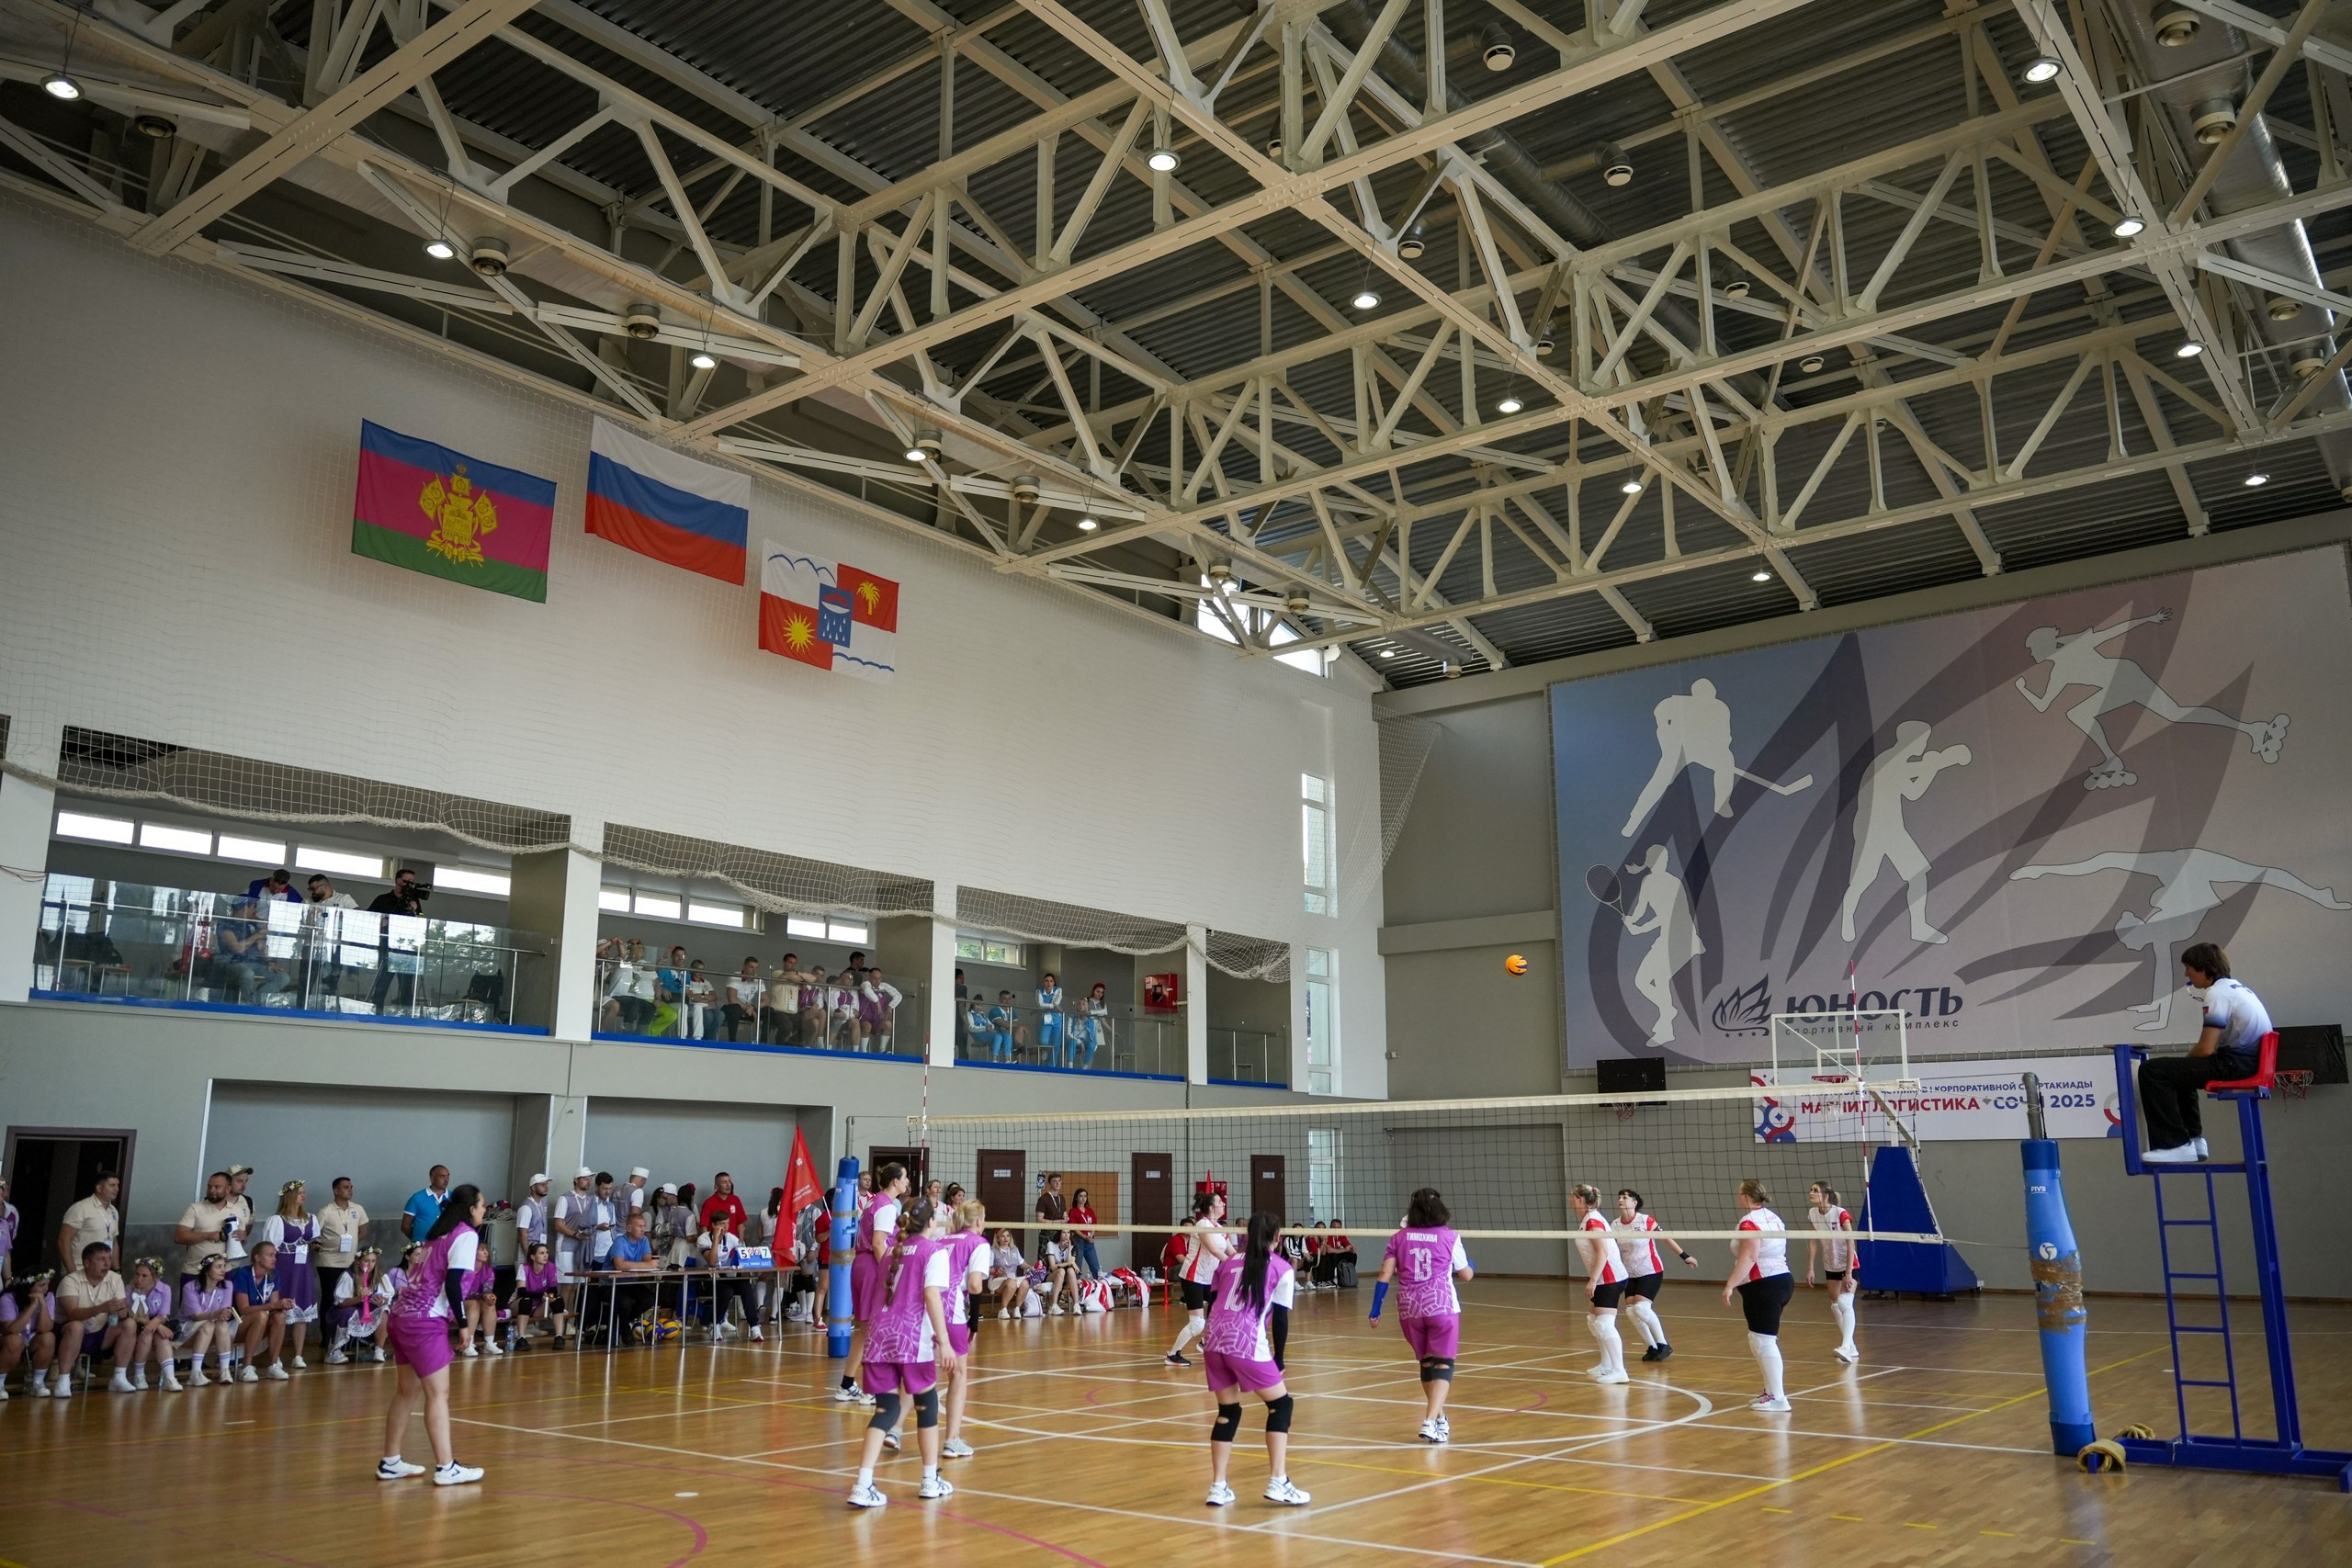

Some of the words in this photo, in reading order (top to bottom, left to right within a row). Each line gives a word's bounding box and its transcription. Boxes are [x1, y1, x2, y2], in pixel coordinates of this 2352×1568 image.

[1785, 987, 1963, 1024] ЮНОСТЬ
[1885, 1019, 1959, 1031] комплекс
[1935, 1081, 2016, 1093] КОРПОРАТИВНОЙ
[2018, 1080, 2093, 1090] СРТАКИАДЫ
[2051, 1094, 2095, 1108] 2025
[741, 1249, 747, 1258] 5
[1408, 1247, 1431, 1281] 13
